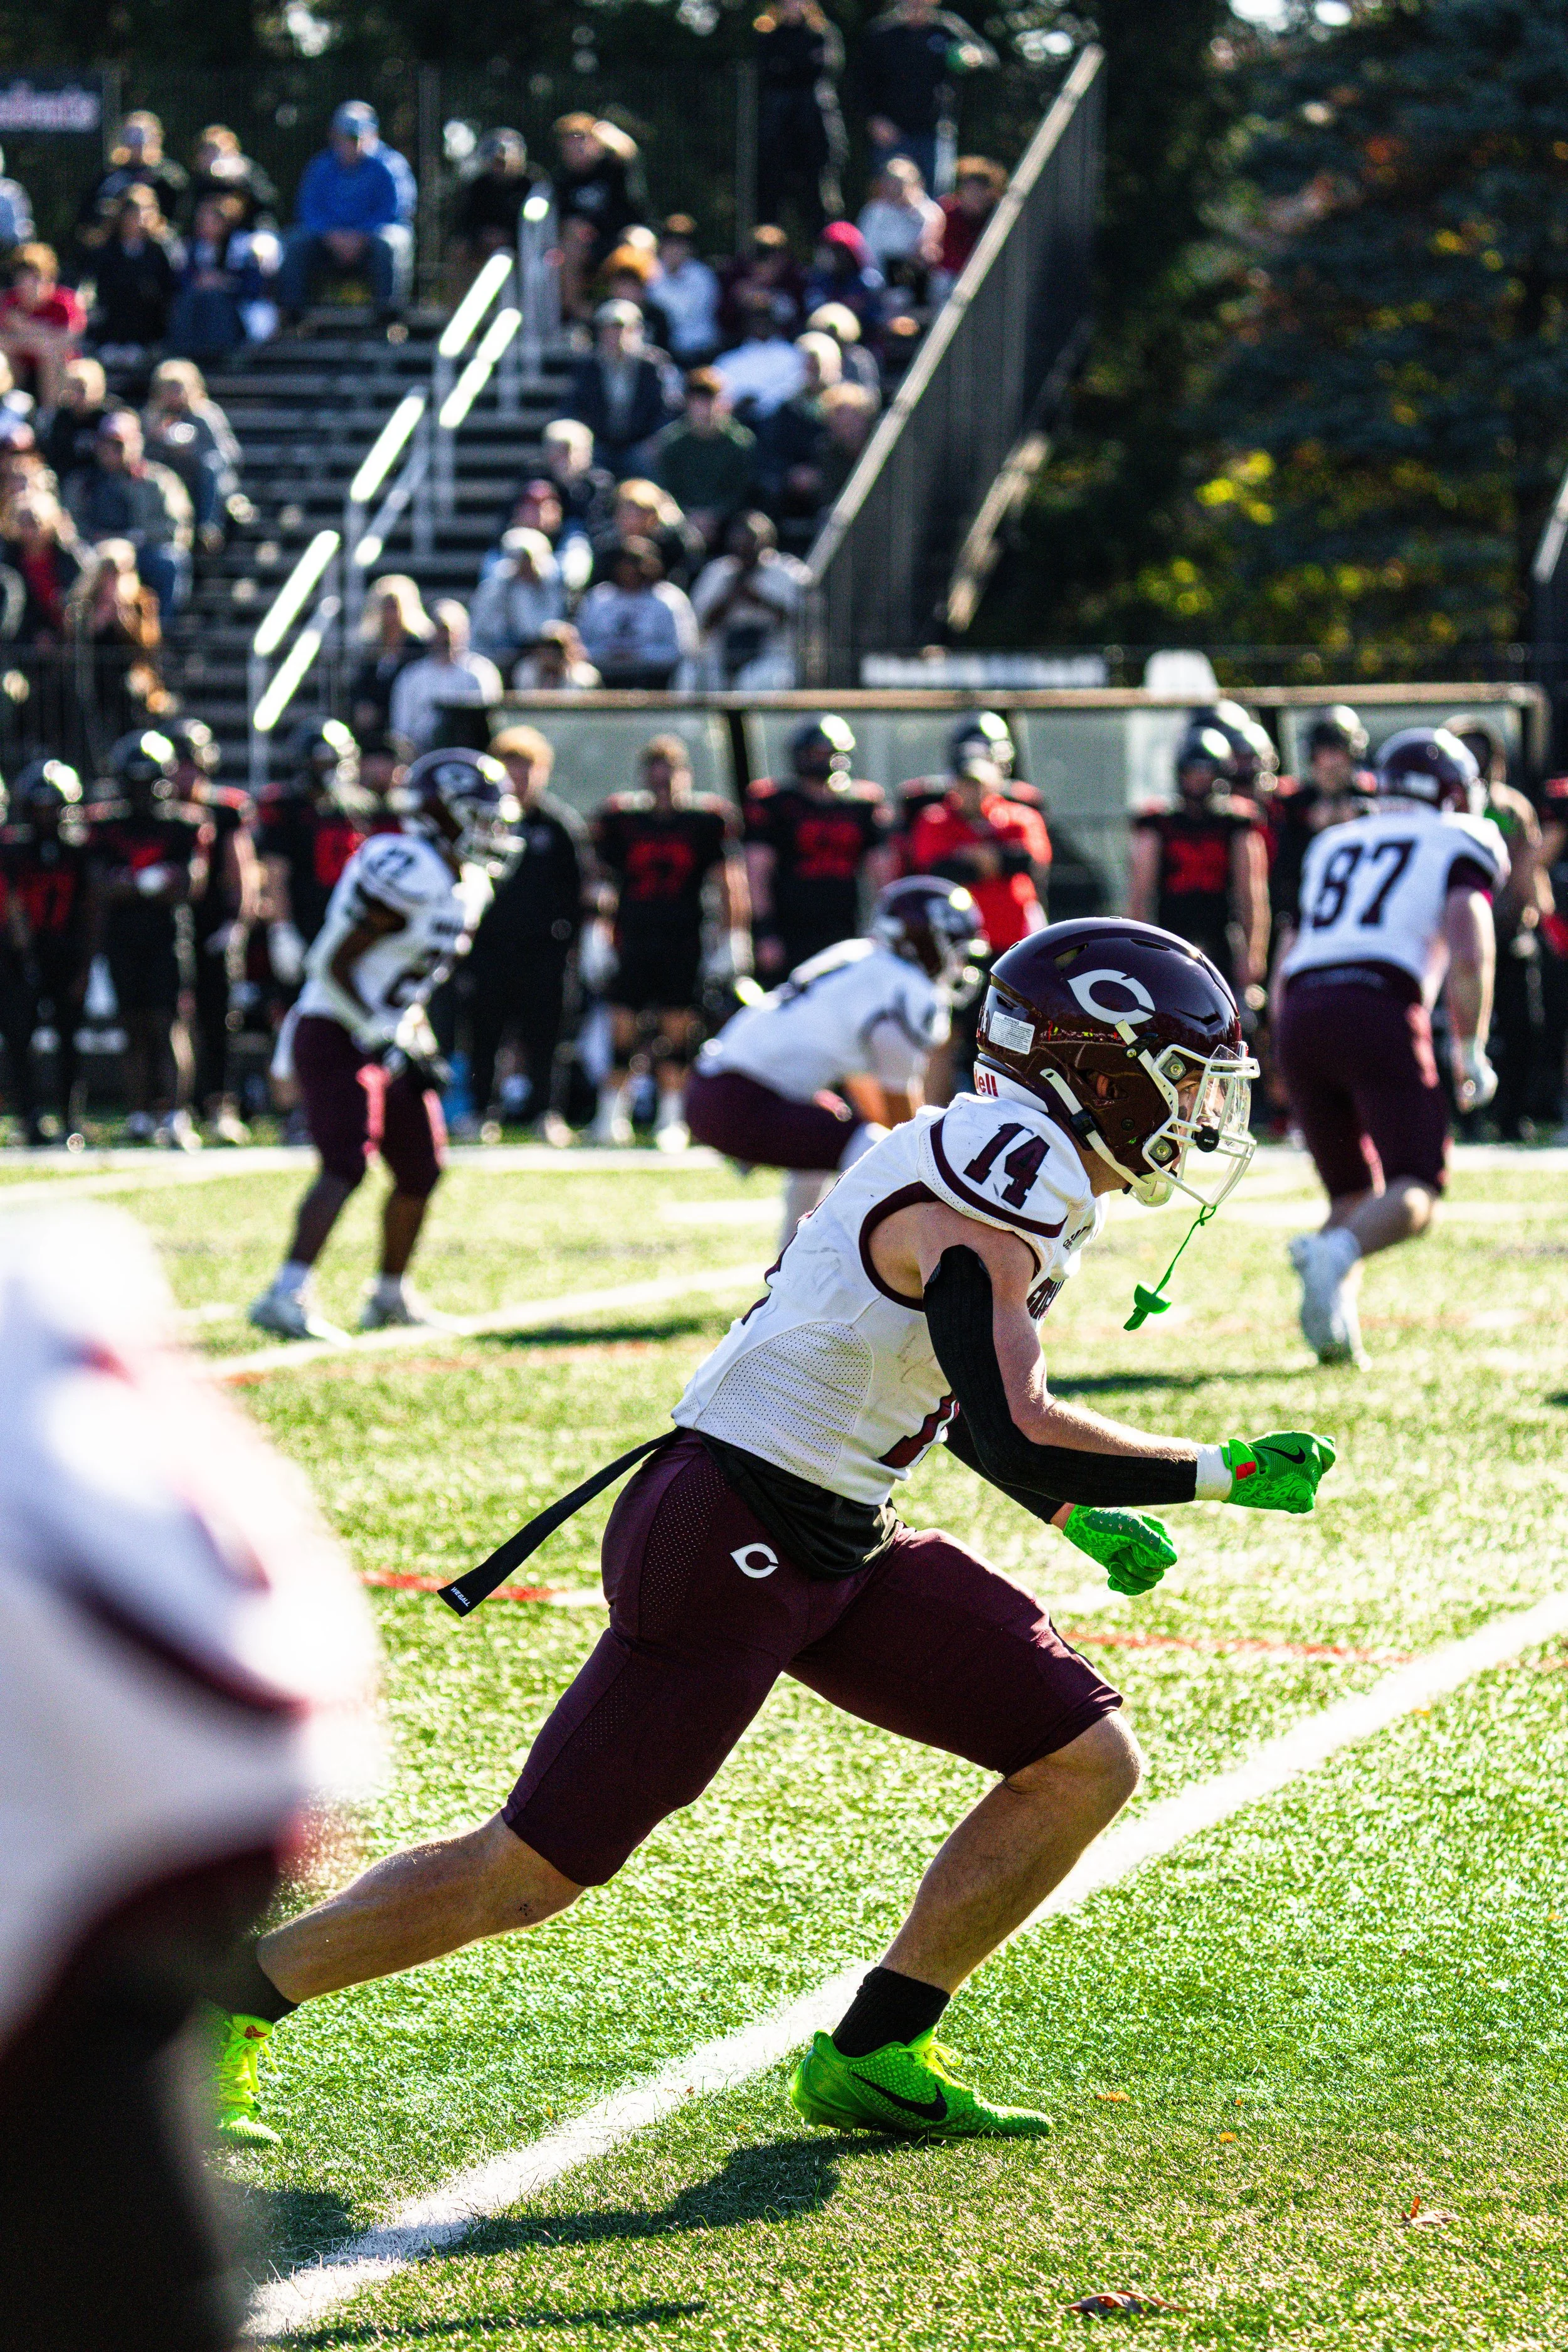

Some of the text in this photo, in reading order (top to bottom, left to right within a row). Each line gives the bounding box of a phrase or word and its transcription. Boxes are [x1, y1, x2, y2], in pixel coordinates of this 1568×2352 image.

[1312, 840, 1419, 930] 87
[1003, 1016, 1020, 1025] WARNING
[963, 1122, 1051, 1210] 14
[729, 1543, 779, 1579] C
